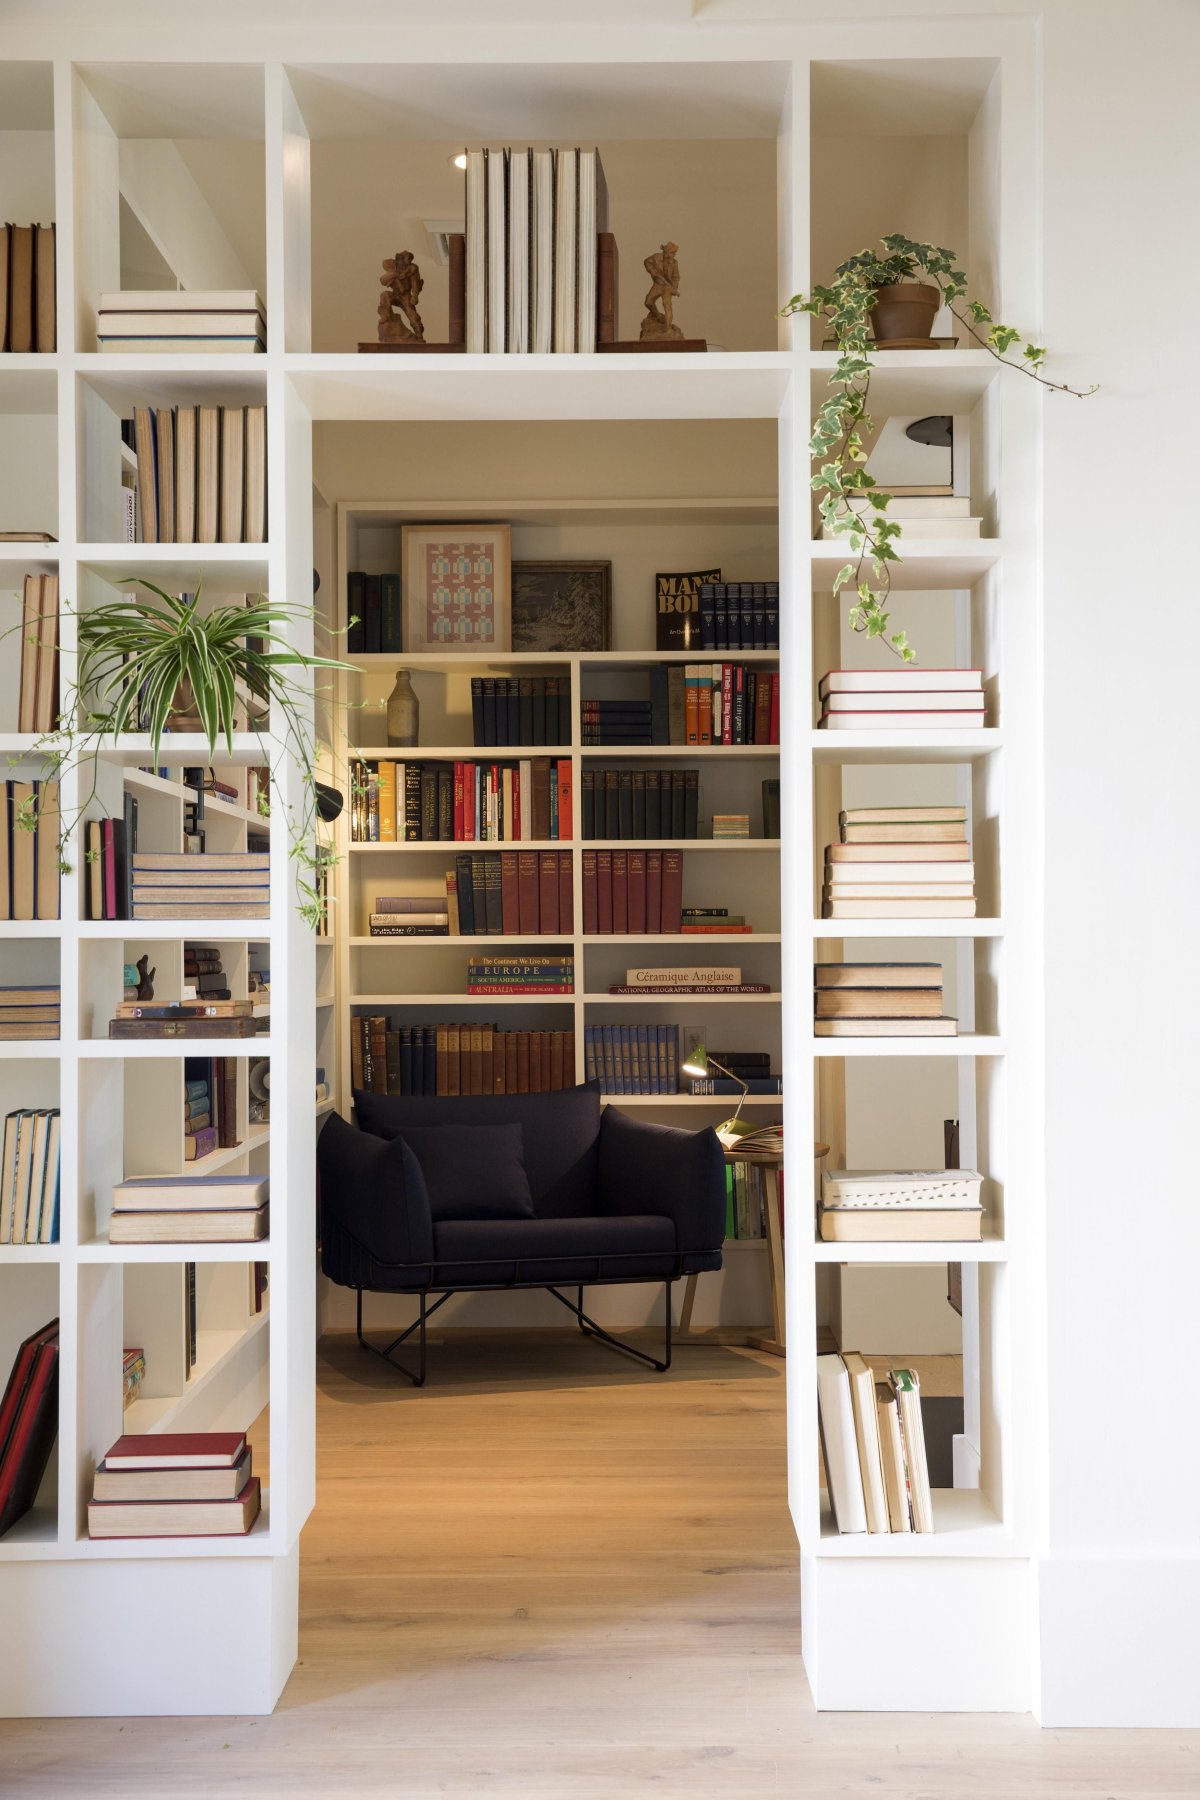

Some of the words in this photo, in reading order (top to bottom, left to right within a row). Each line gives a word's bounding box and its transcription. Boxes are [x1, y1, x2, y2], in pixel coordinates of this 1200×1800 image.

[659, 595, 699, 613] BO
[484, 967, 540, 975] EUROPE
[636, 971, 689, 985] Céramique
[692, 970, 734, 985] Anglaise
